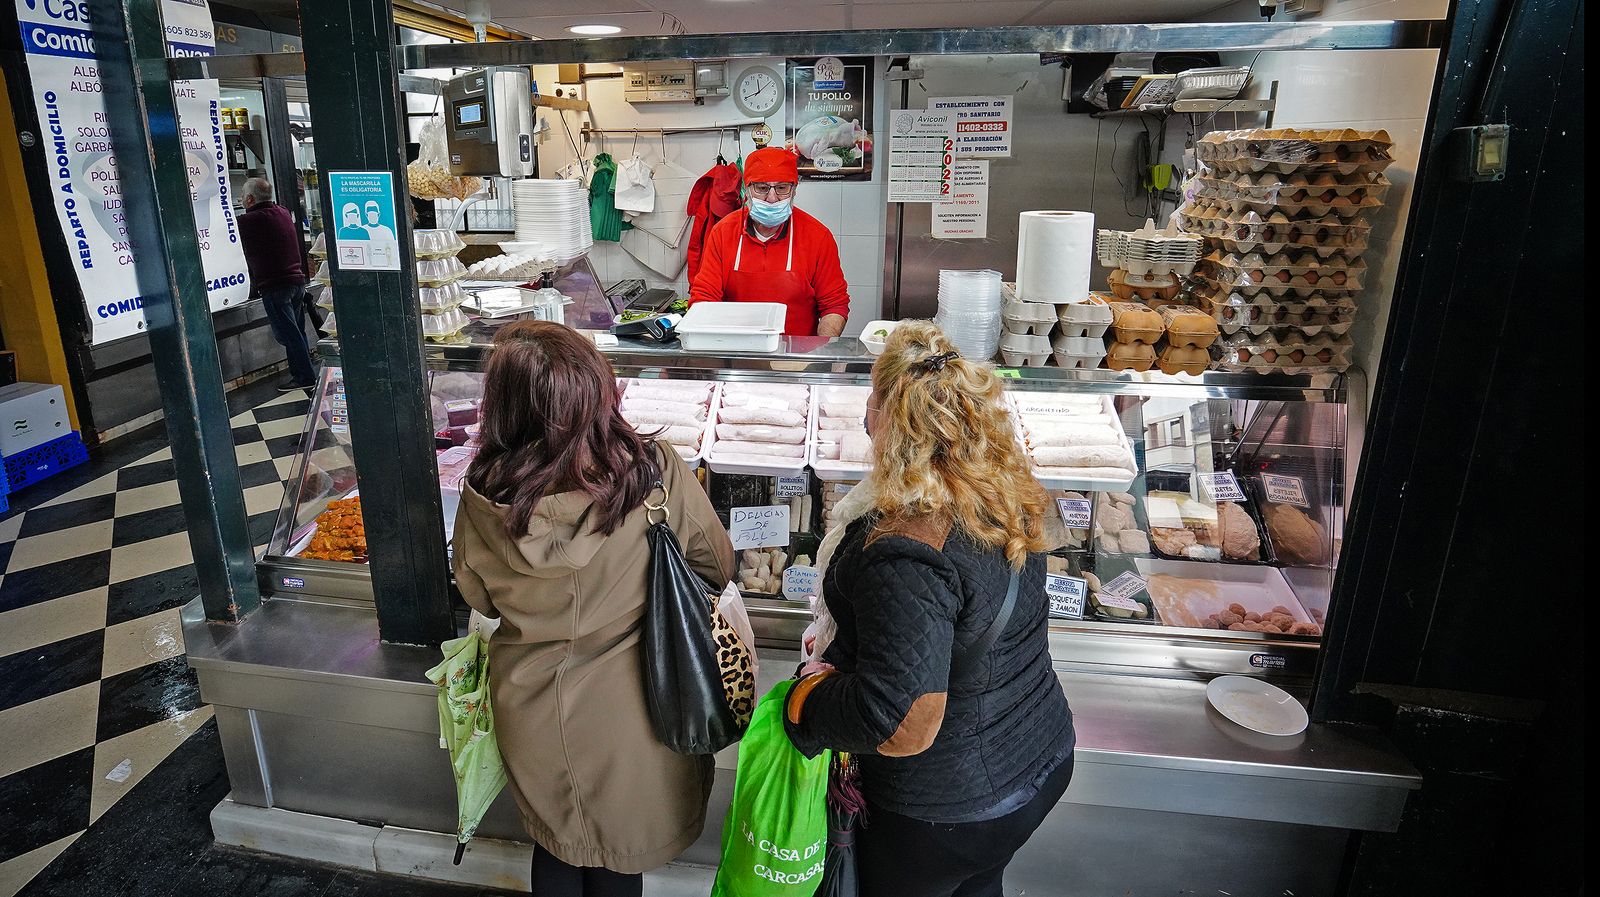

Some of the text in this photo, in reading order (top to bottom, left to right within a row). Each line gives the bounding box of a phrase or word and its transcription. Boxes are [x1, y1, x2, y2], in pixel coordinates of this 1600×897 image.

[184, 28, 198, 37] 823
[200, 30, 212, 39] 589
[216, 26, 237, 43] AS
[808, 92, 851, 101] TU POLLO
[936, 101, 989, 109] ESTABLECIMIENTO
[94, 112, 108, 123] RI
[75, 142, 114, 152] GARBA
[186, 166, 201, 176] RA
[210, 100, 237, 244] REPARTO A DOMICILIO
[44, 91, 93, 269] REPARTO A DOMICILIO
[103, 199, 125, 210] JUD
[198, 229, 210, 238] TE
[759, 840, 801, 861] CASA
[804, 839, 820, 860] DE
